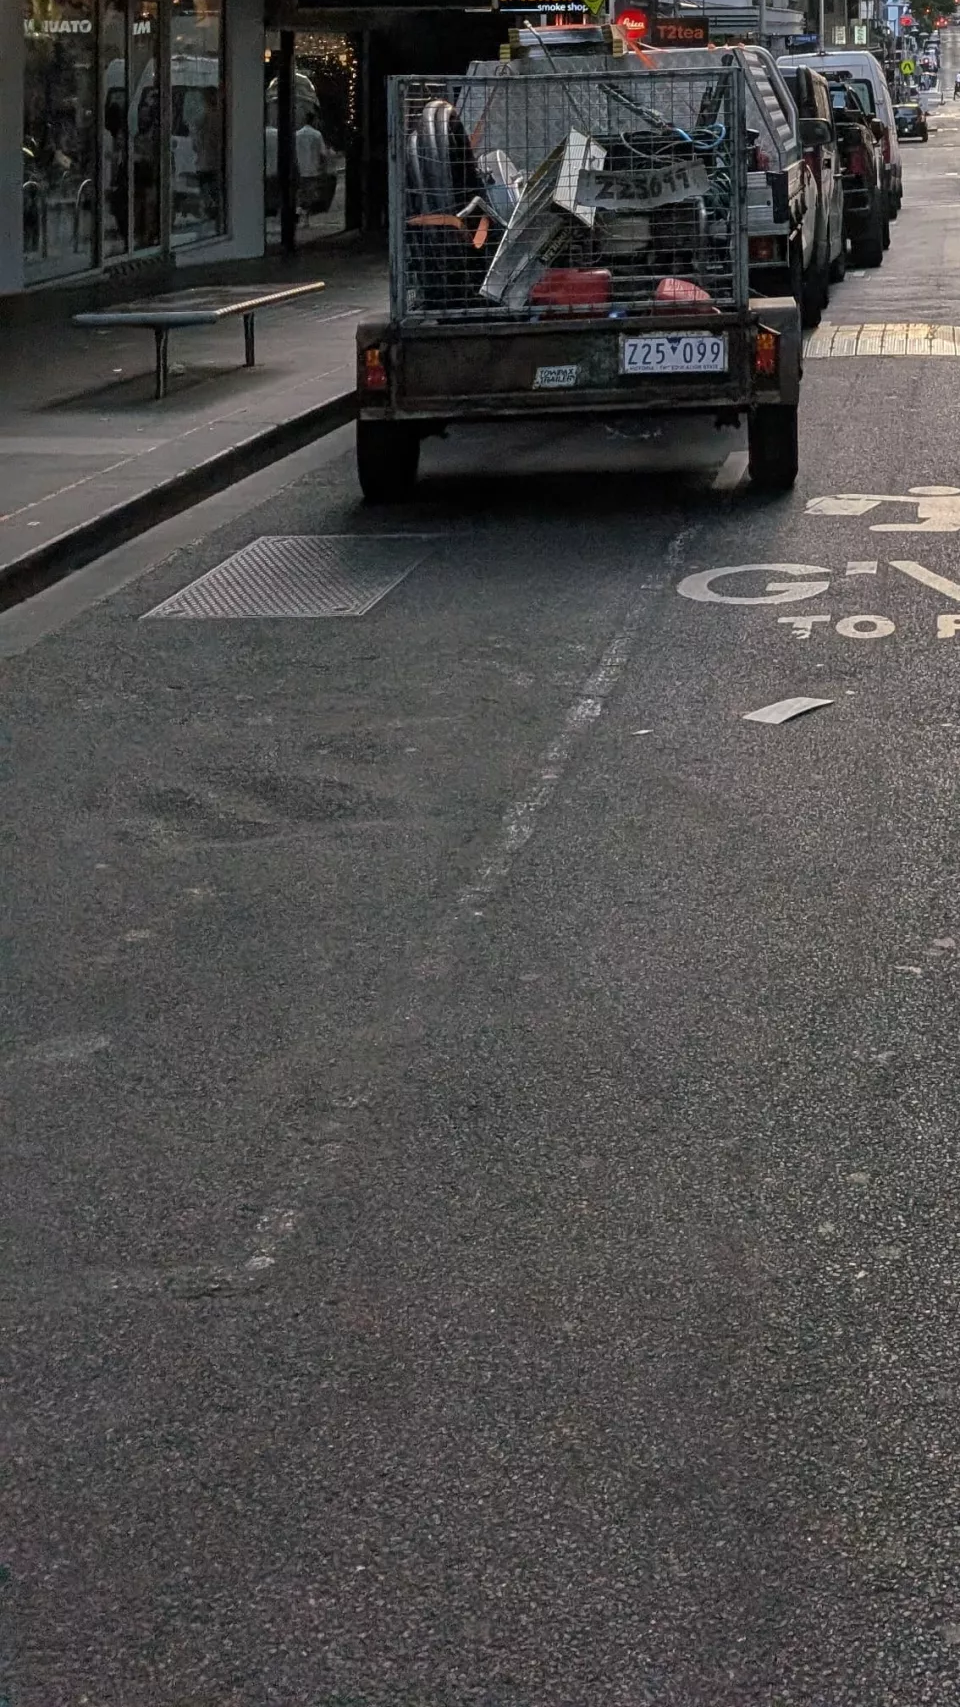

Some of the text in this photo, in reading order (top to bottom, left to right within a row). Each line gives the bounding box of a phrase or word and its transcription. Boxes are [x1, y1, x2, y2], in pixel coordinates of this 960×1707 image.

[537, 3, 566, 12] smoke
[621, 17, 646, 30] Leica
[656, 24, 704, 40] T2tea
[627, 341, 721, 365] Z25 099
